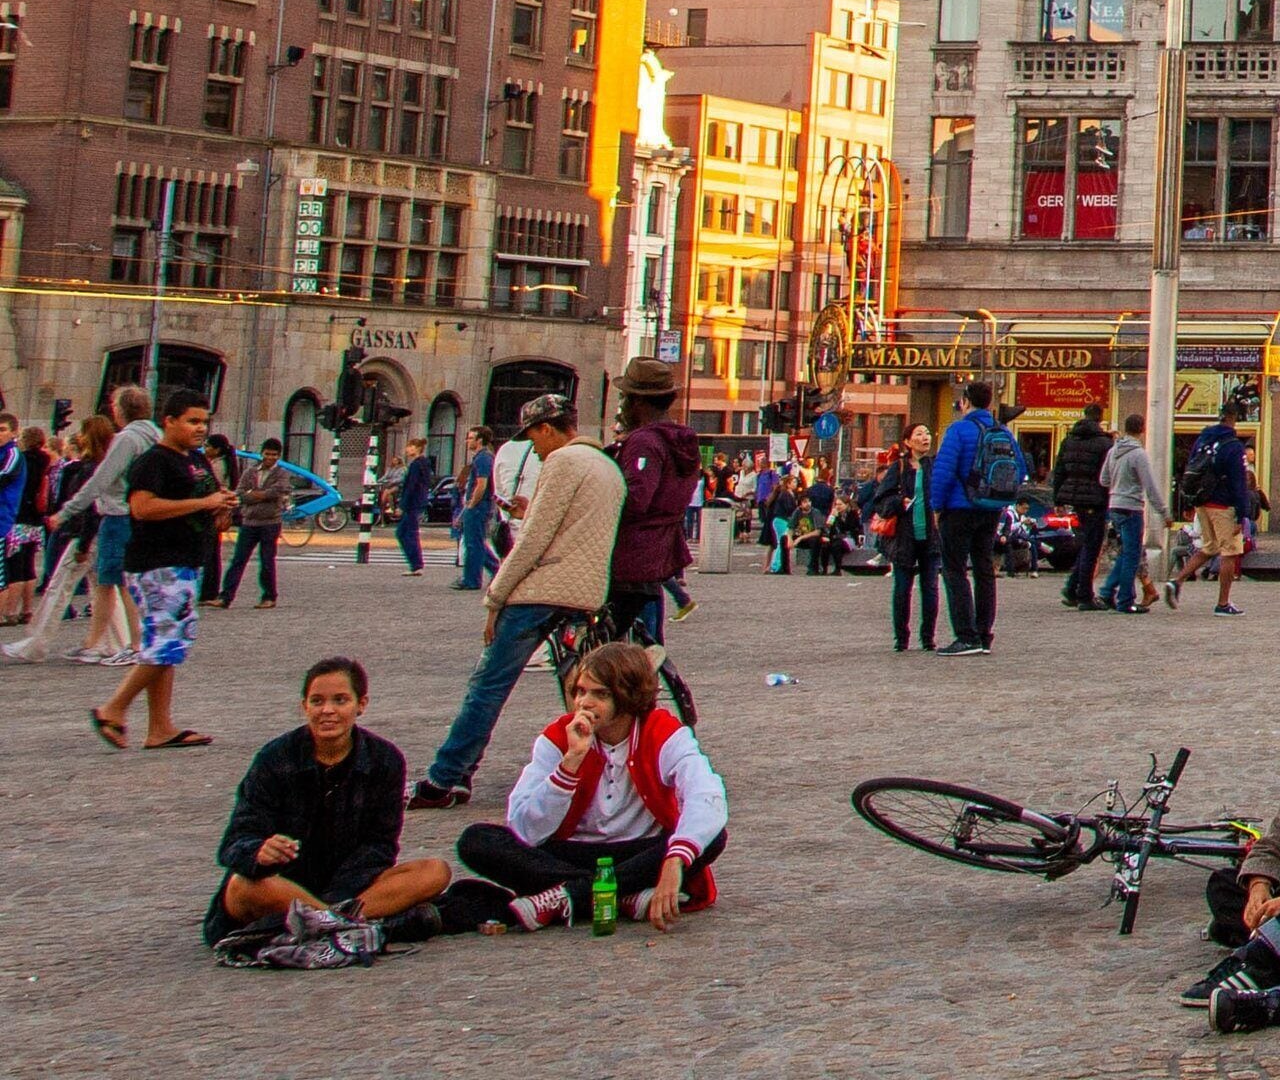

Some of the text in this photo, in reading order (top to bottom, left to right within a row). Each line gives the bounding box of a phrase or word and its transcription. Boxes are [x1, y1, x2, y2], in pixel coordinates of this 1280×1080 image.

[351, 328, 418, 349] GASSAN
[865, 347, 1092, 368] MADAME TUSSAUD
[1039, 379, 1094, 403] Tussauds
